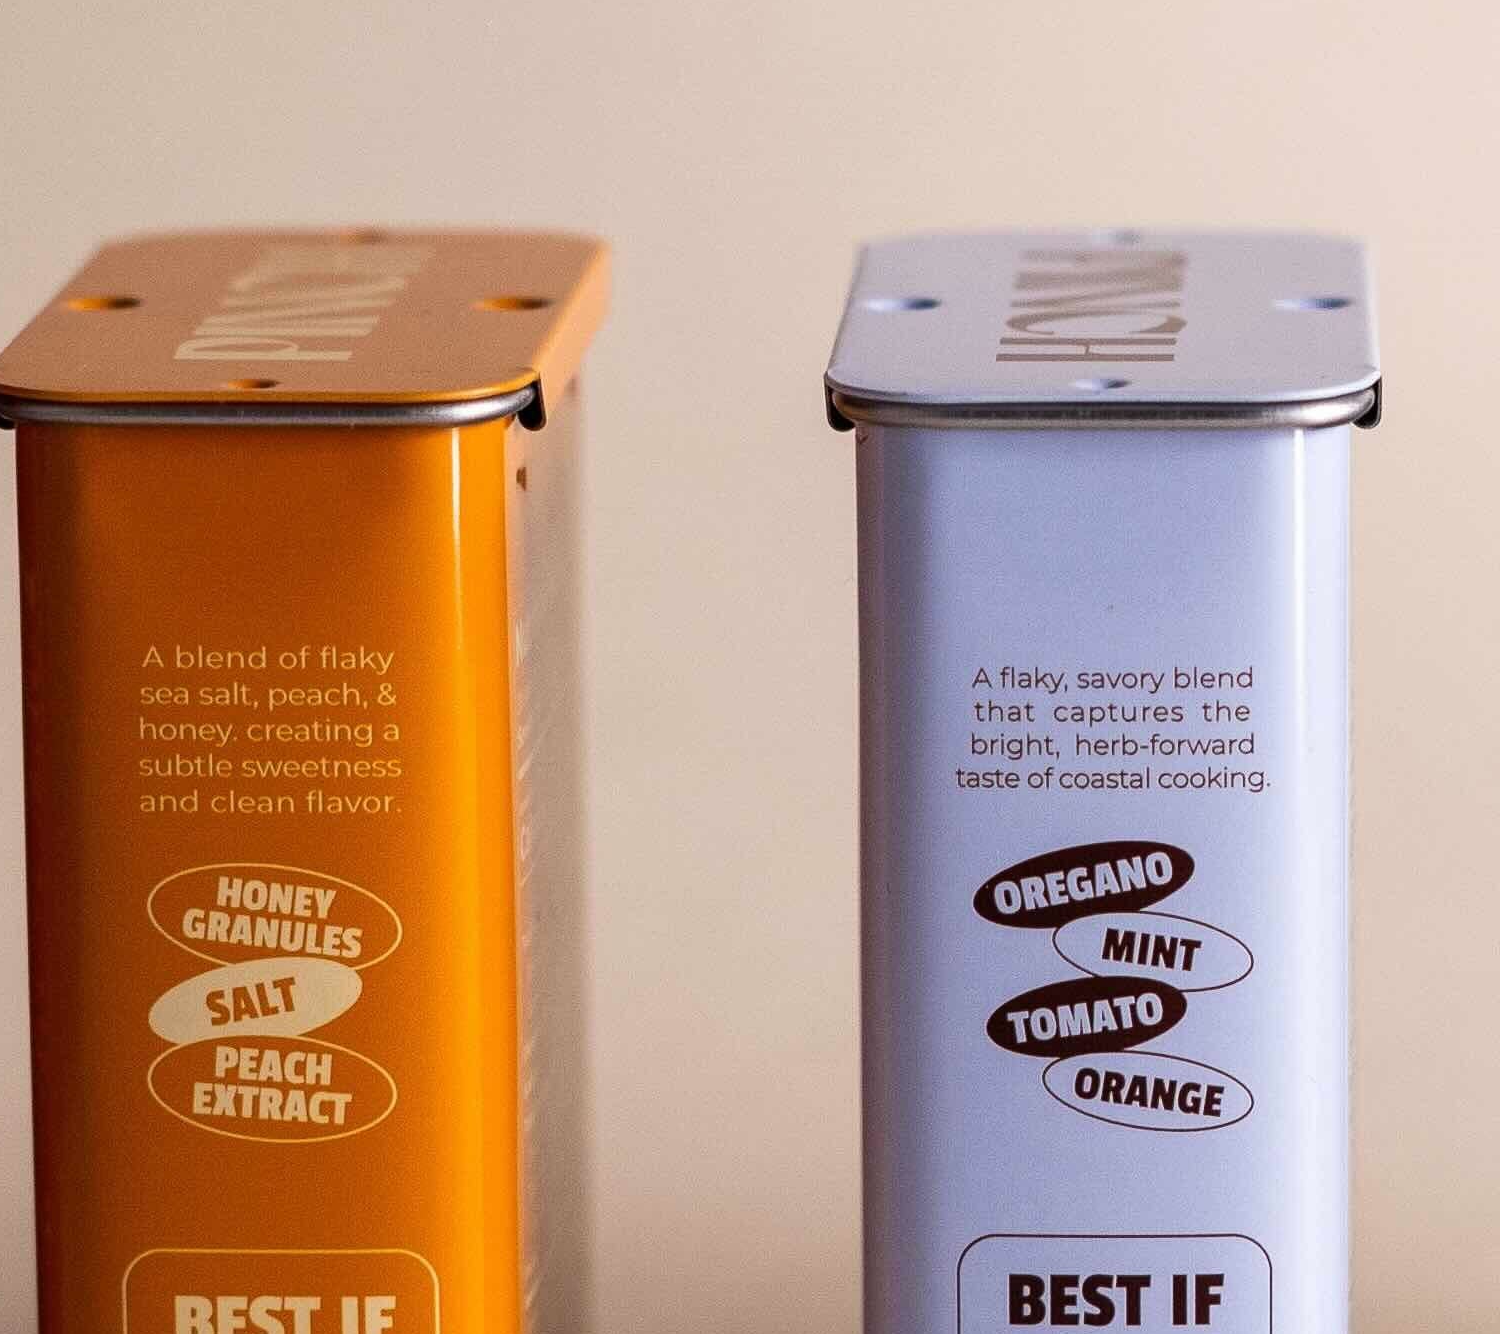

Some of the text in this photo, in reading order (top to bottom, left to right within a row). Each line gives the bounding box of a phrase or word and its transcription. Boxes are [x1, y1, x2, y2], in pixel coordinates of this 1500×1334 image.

[141, 644, 394, 676] A blend of flaky
[971, 665, 1253, 695] A flaky, savory blend
[974, 699, 1251, 728] that captures the
[971, 732, 1255, 761] bright, herb-forward
[139, 789, 401, 814] and clean flavor.
[217, 875, 337, 920] HONEY
[993, 851, 1174, 916] OREGANO
[182, 907, 364, 959] GRANULES
[1101, 928, 1203, 972] MINT
[204, 976, 297, 1027] SALT
[1007, 992, 1164, 1044] TOMATO
[214, 1045, 333, 1086] PEACH
[192, 1082, 353, 1126] EXTRACT
[1073, 1067, 1225, 1118] ORANGE
[1008, 1273, 1225, 1326] BEST IF
